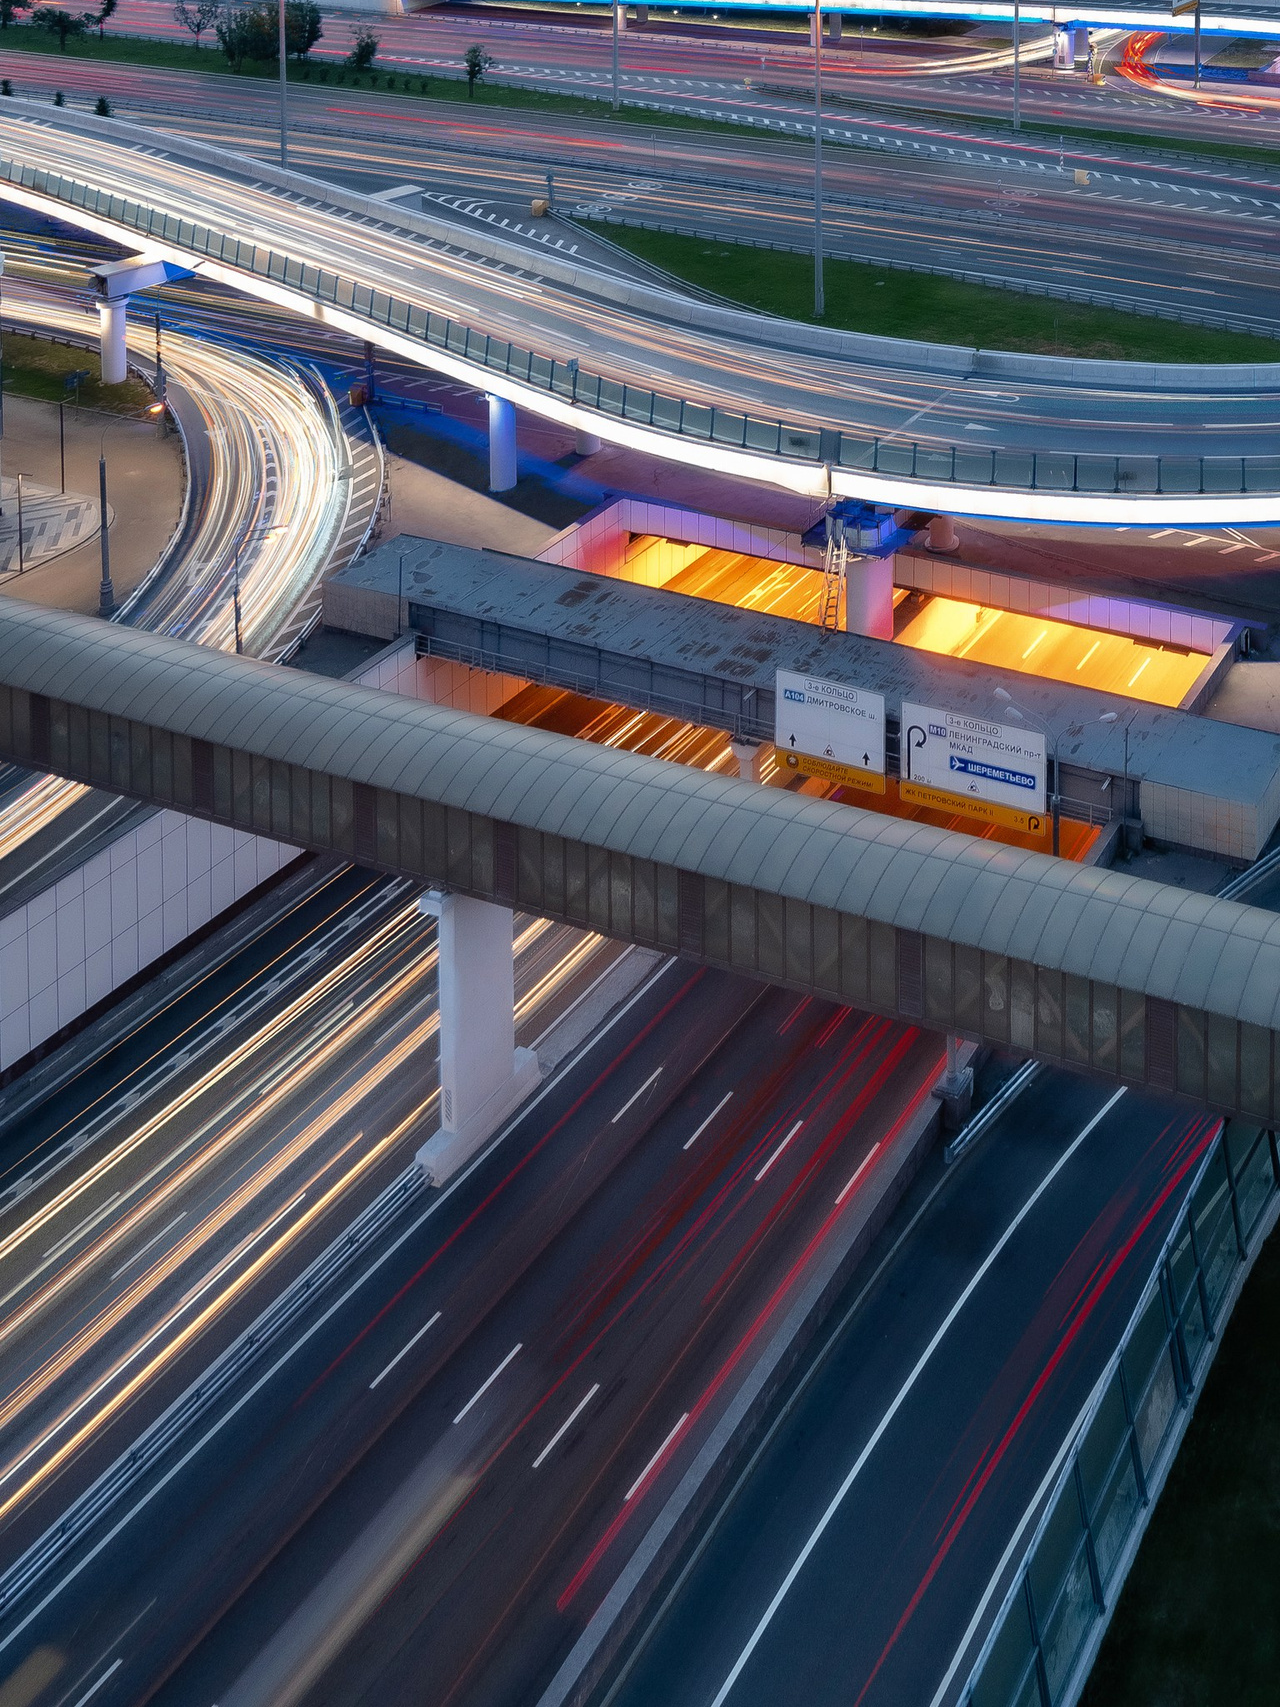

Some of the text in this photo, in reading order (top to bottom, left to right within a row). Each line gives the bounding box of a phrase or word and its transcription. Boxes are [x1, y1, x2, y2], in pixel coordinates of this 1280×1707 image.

[808, 681, 855, 700] 3-е КОЛЬЦО
[807, 696, 866, 718] ДМИТРОВСКОЕ
[949, 717, 999, 735] 3-е КОЛЬЦО
[949, 731, 1022, 754] ЛЕНИНГРАДСКИЙ
[1024, 750, 1041, 759] пр-т
[949, 742, 974, 755] МКАД
[802, 758, 849, 775] СОБЛЮДАЙТЕ
[802, 766, 846, 782] СКОРОСТНОЙ
[968, 763, 1034, 786] ШЕРЕМЕТЬЕВО
[913, 774, 925, 782] 200
[905, 788, 917, 797] ЖК
[918, 791, 966, 809] ПЕТРОВСКИЙ
[968, 804, 988, 815] ПАРК
